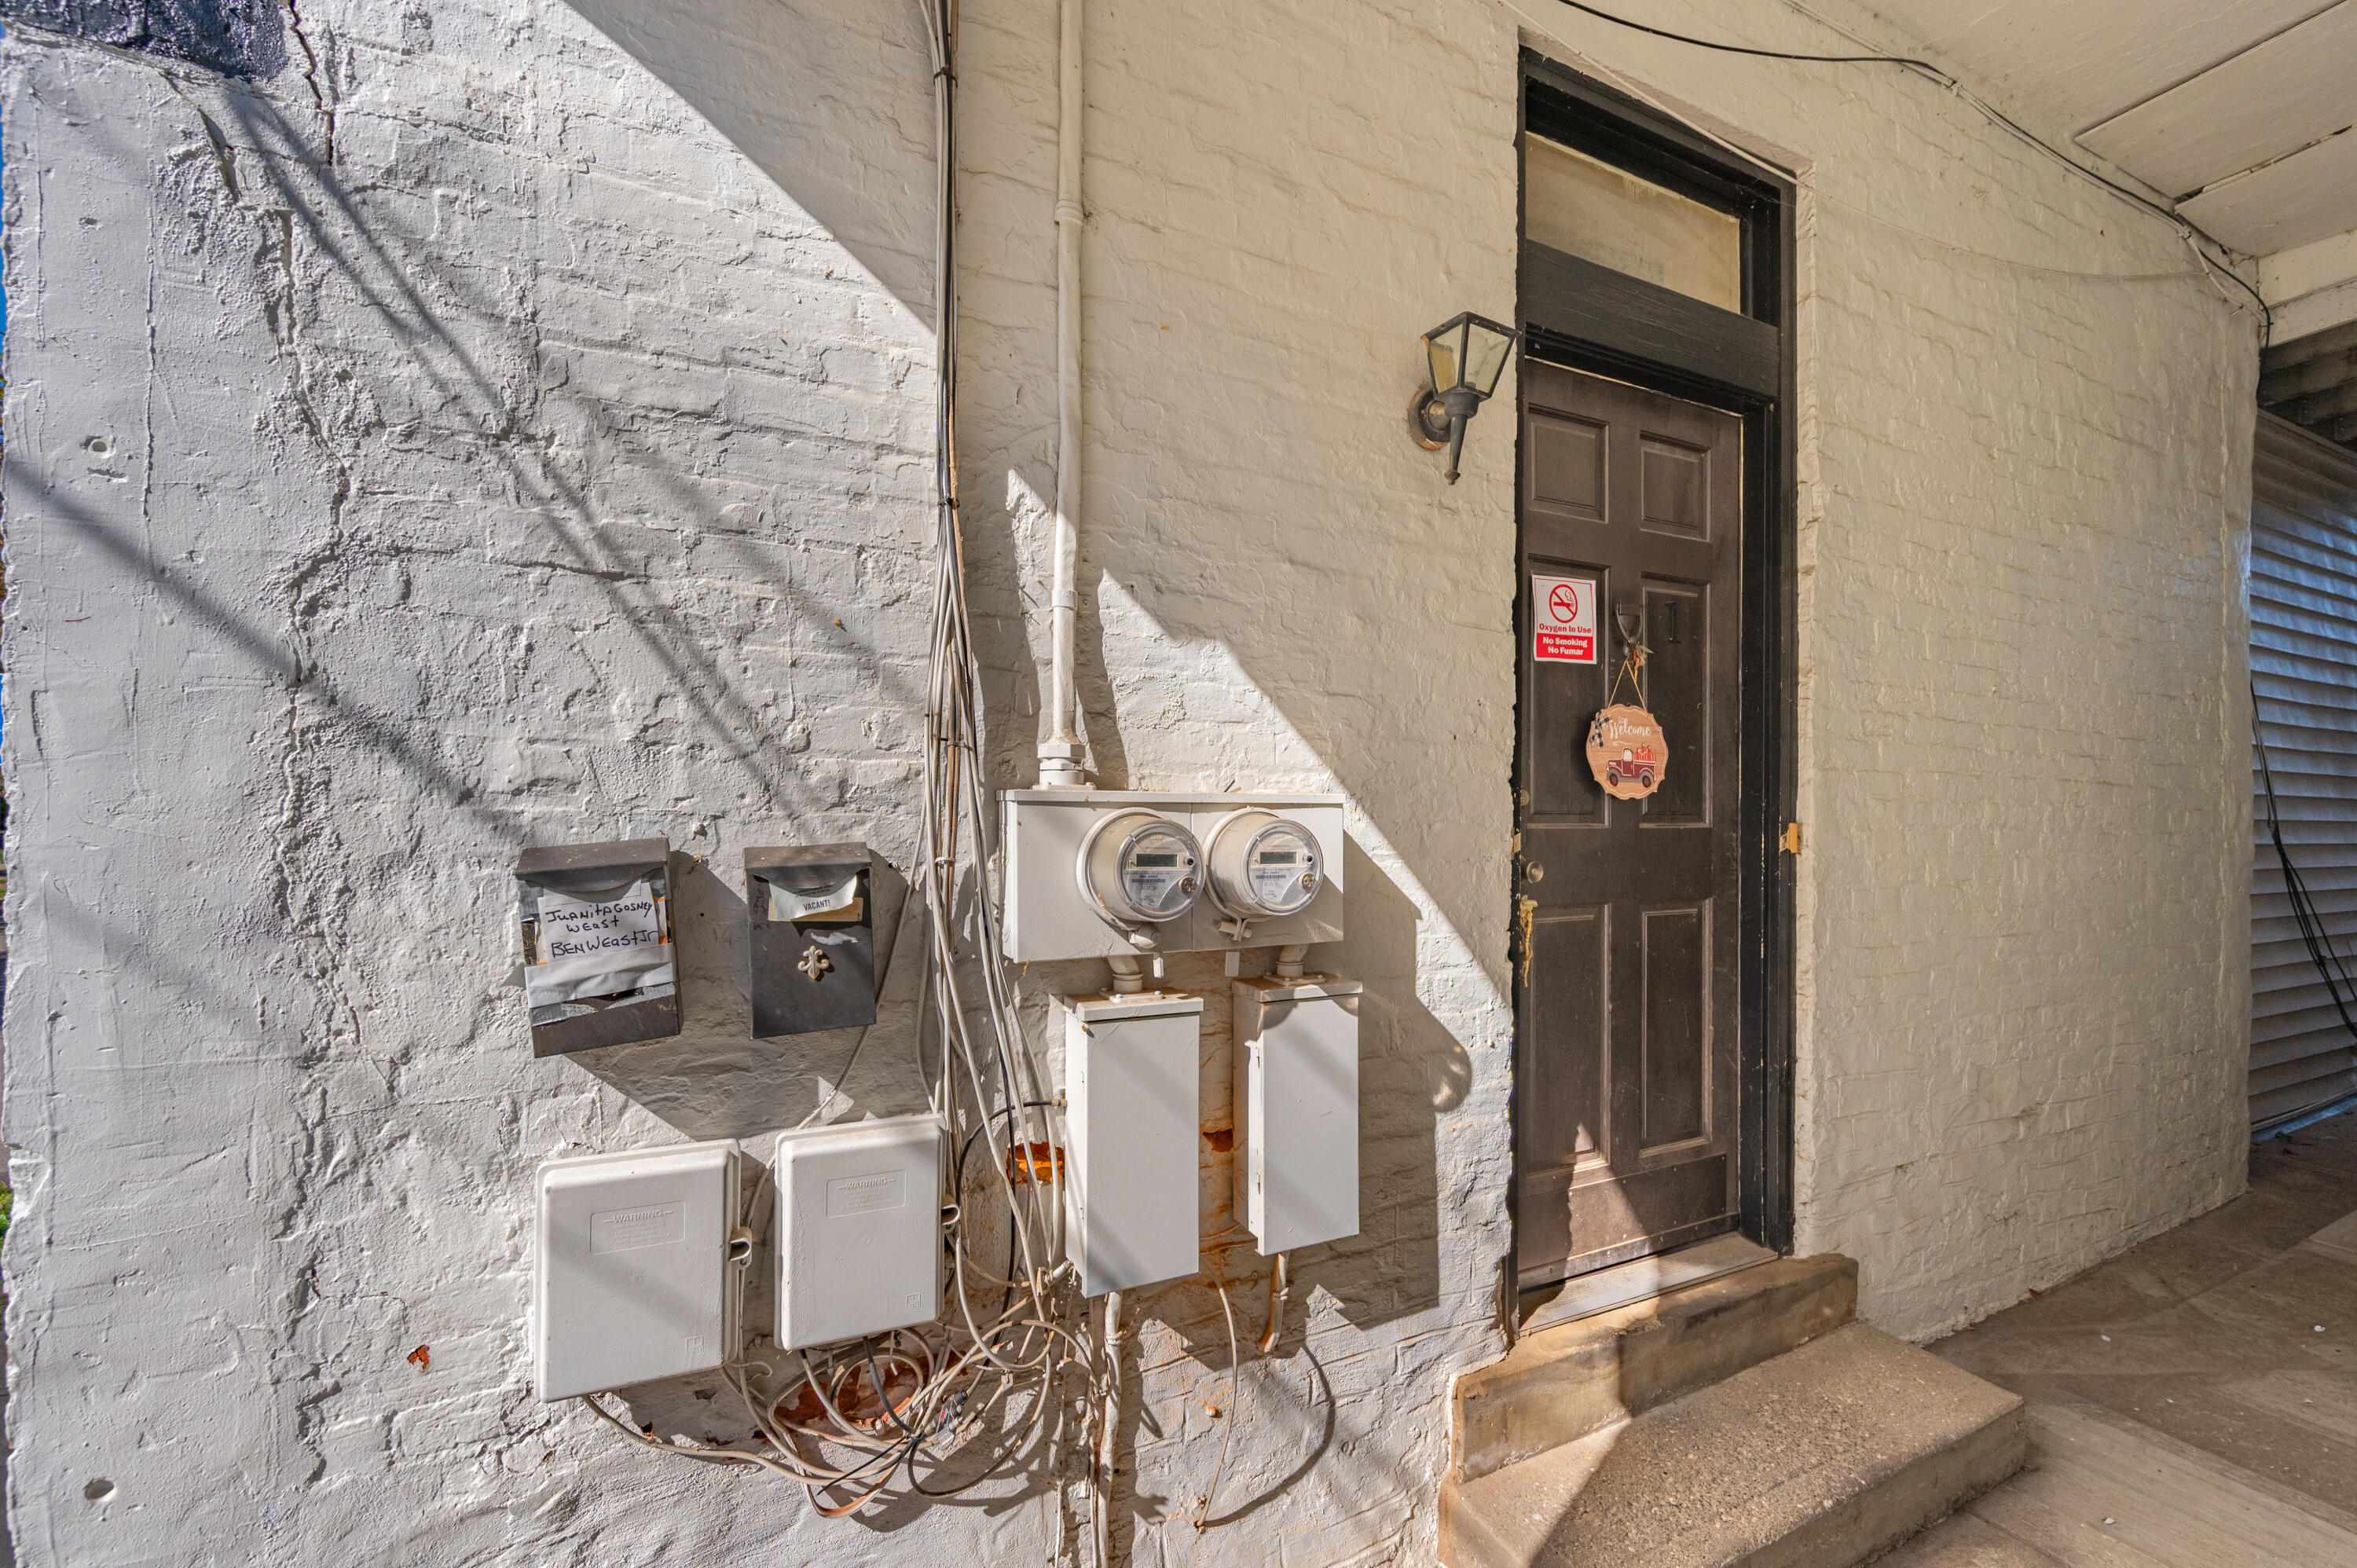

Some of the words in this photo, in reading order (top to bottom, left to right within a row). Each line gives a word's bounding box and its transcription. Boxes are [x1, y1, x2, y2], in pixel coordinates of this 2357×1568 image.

[1539, 623, 1567, 633] Oxygen
[1555, 637, 1588, 648] Smoking
[1560, 647, 1584, 655] Fumar
[1603, 716, 1651, 739] Welcome
[803, 899, 830, 911] VACANT!
[552, 941, 586, 958] BEN
[845, 1177, 887, 1189] WARNING
[613, 1209, 663, 1223] WARNING
